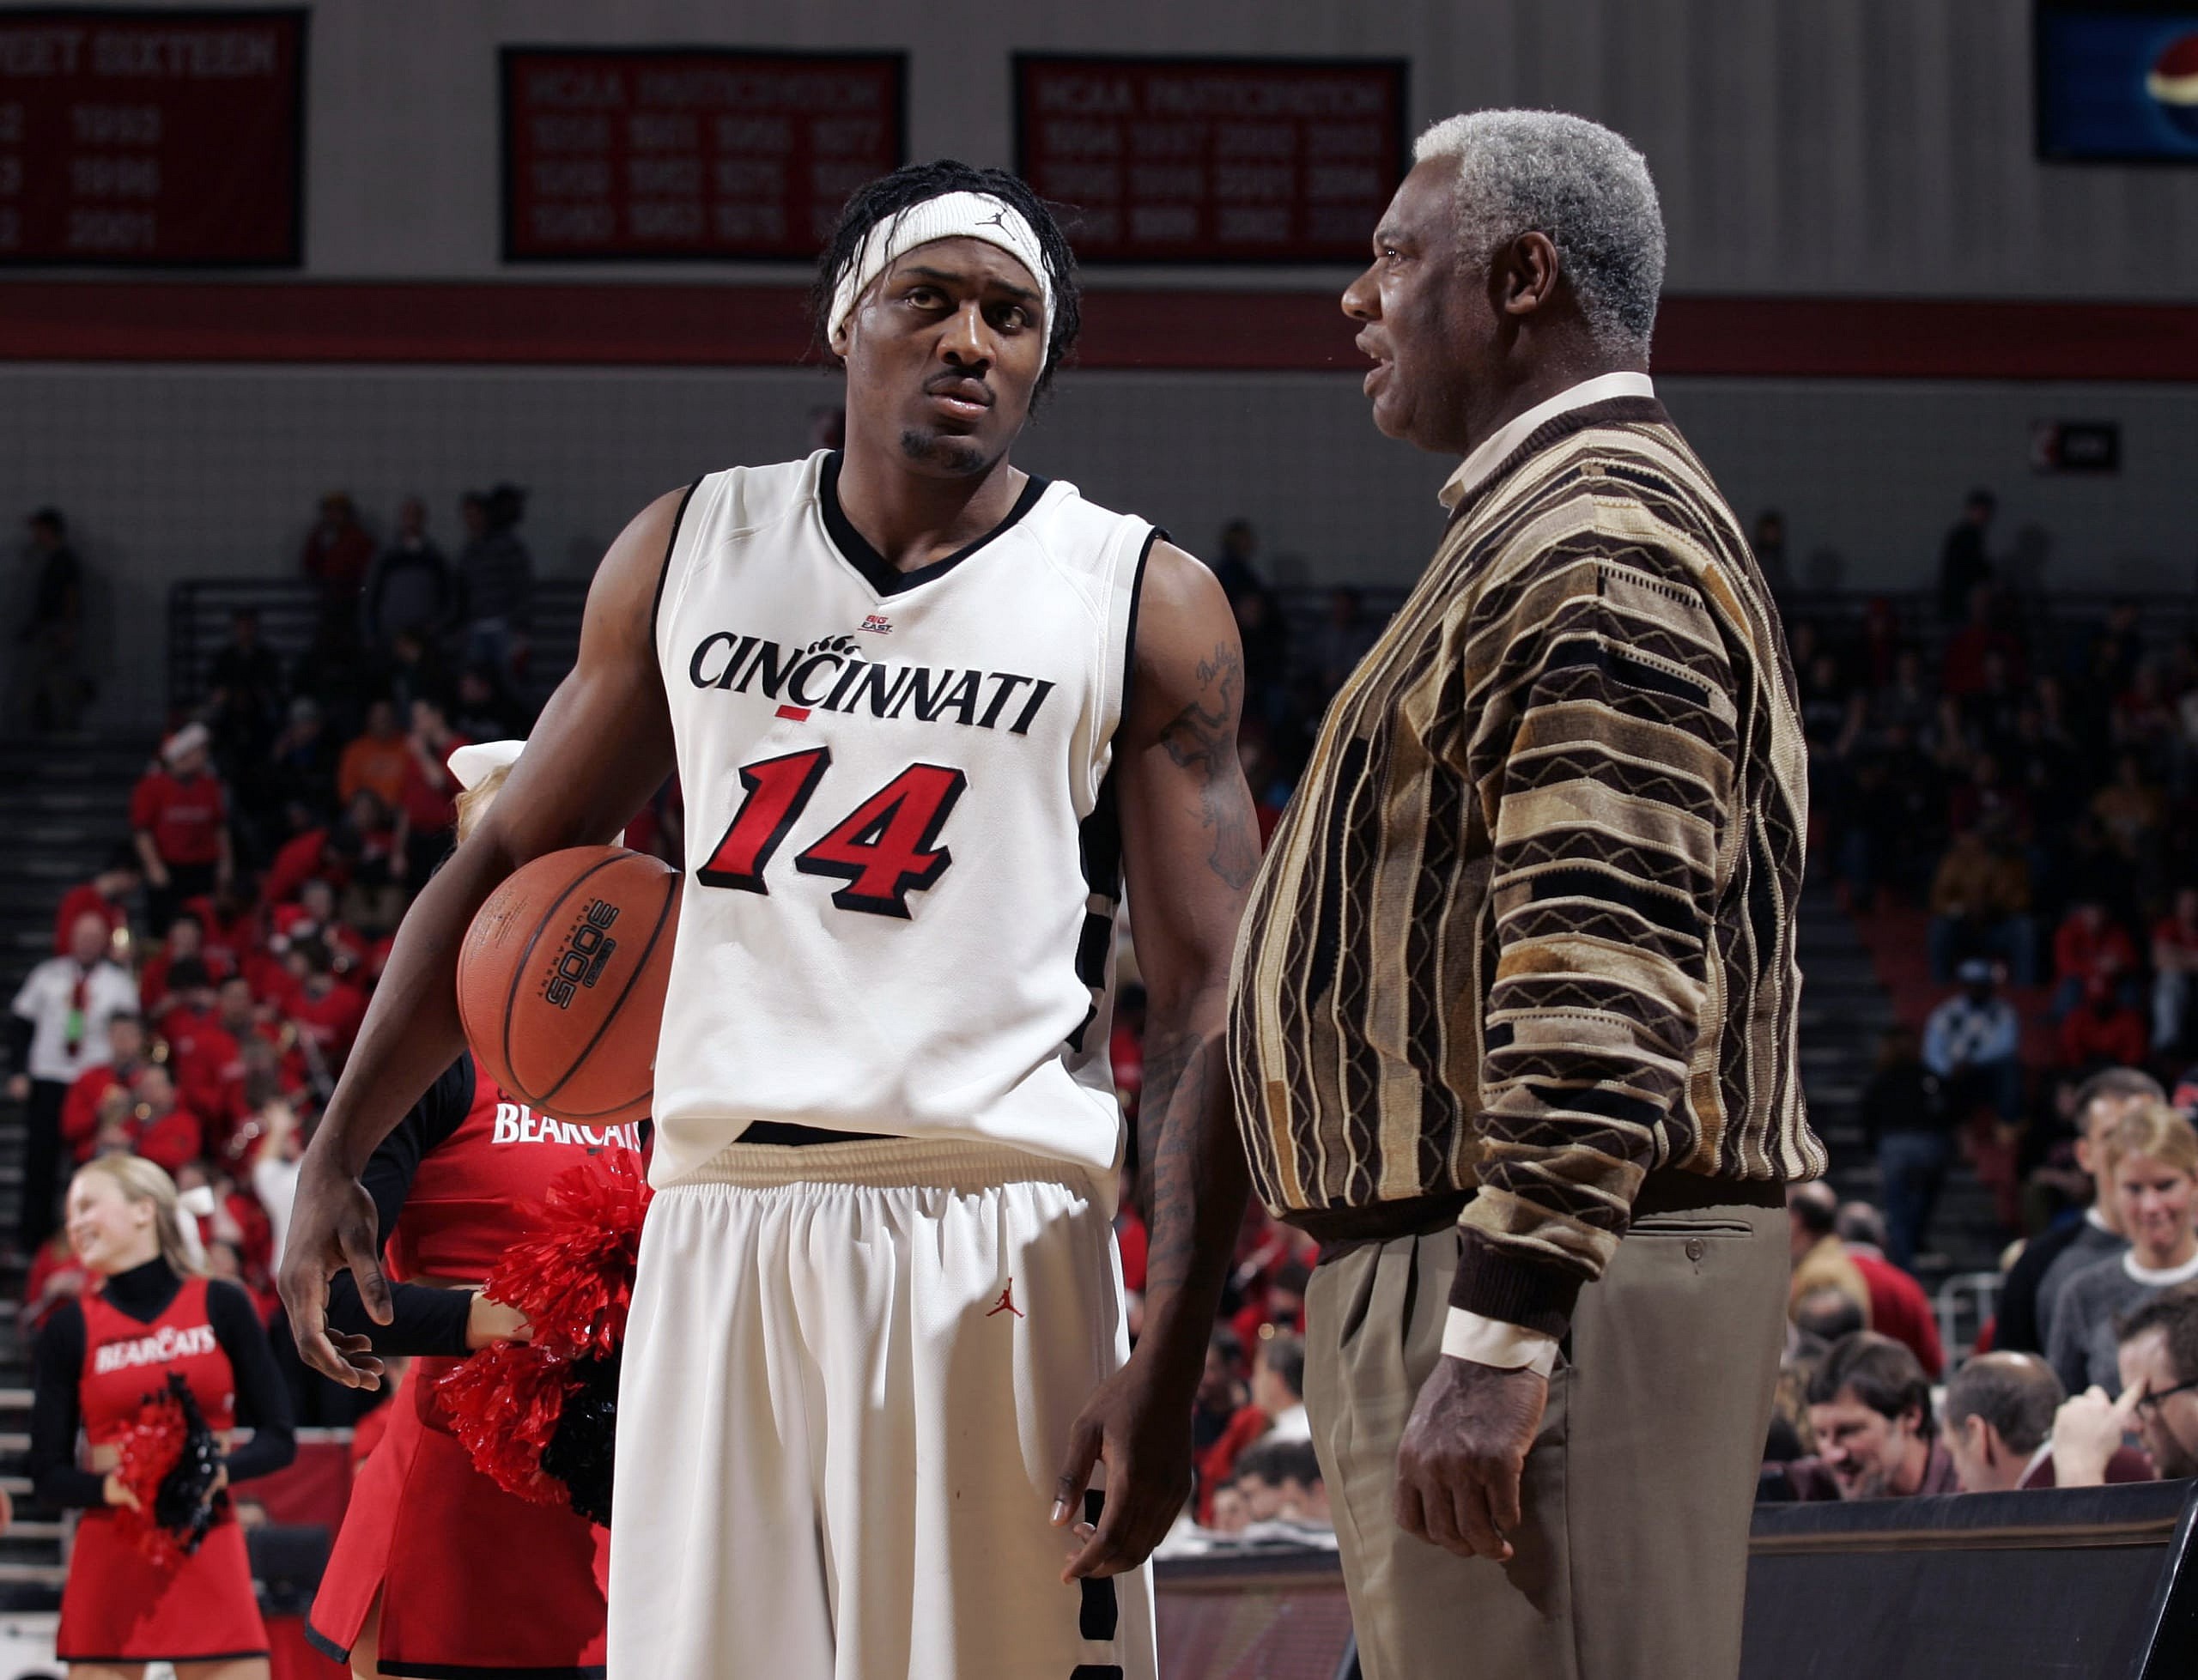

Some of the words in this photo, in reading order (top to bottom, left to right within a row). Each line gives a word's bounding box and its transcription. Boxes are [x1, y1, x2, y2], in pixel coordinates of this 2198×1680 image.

[0, 28, 82, 75] EET
[94, 31, 276, 76] SIXTEEN
[861, 622, 893, 632] EAST
[865, 615, 889, 623] BIG
[689, 631, 1056, 736] CINCINNATI
[696, 745, 968, 920] 14
[535, 897, 595, 999] TOURNAMENT
[545, 899, 620, 1010] 3005
[94, 1324, 216, 1375] BEARCATS
